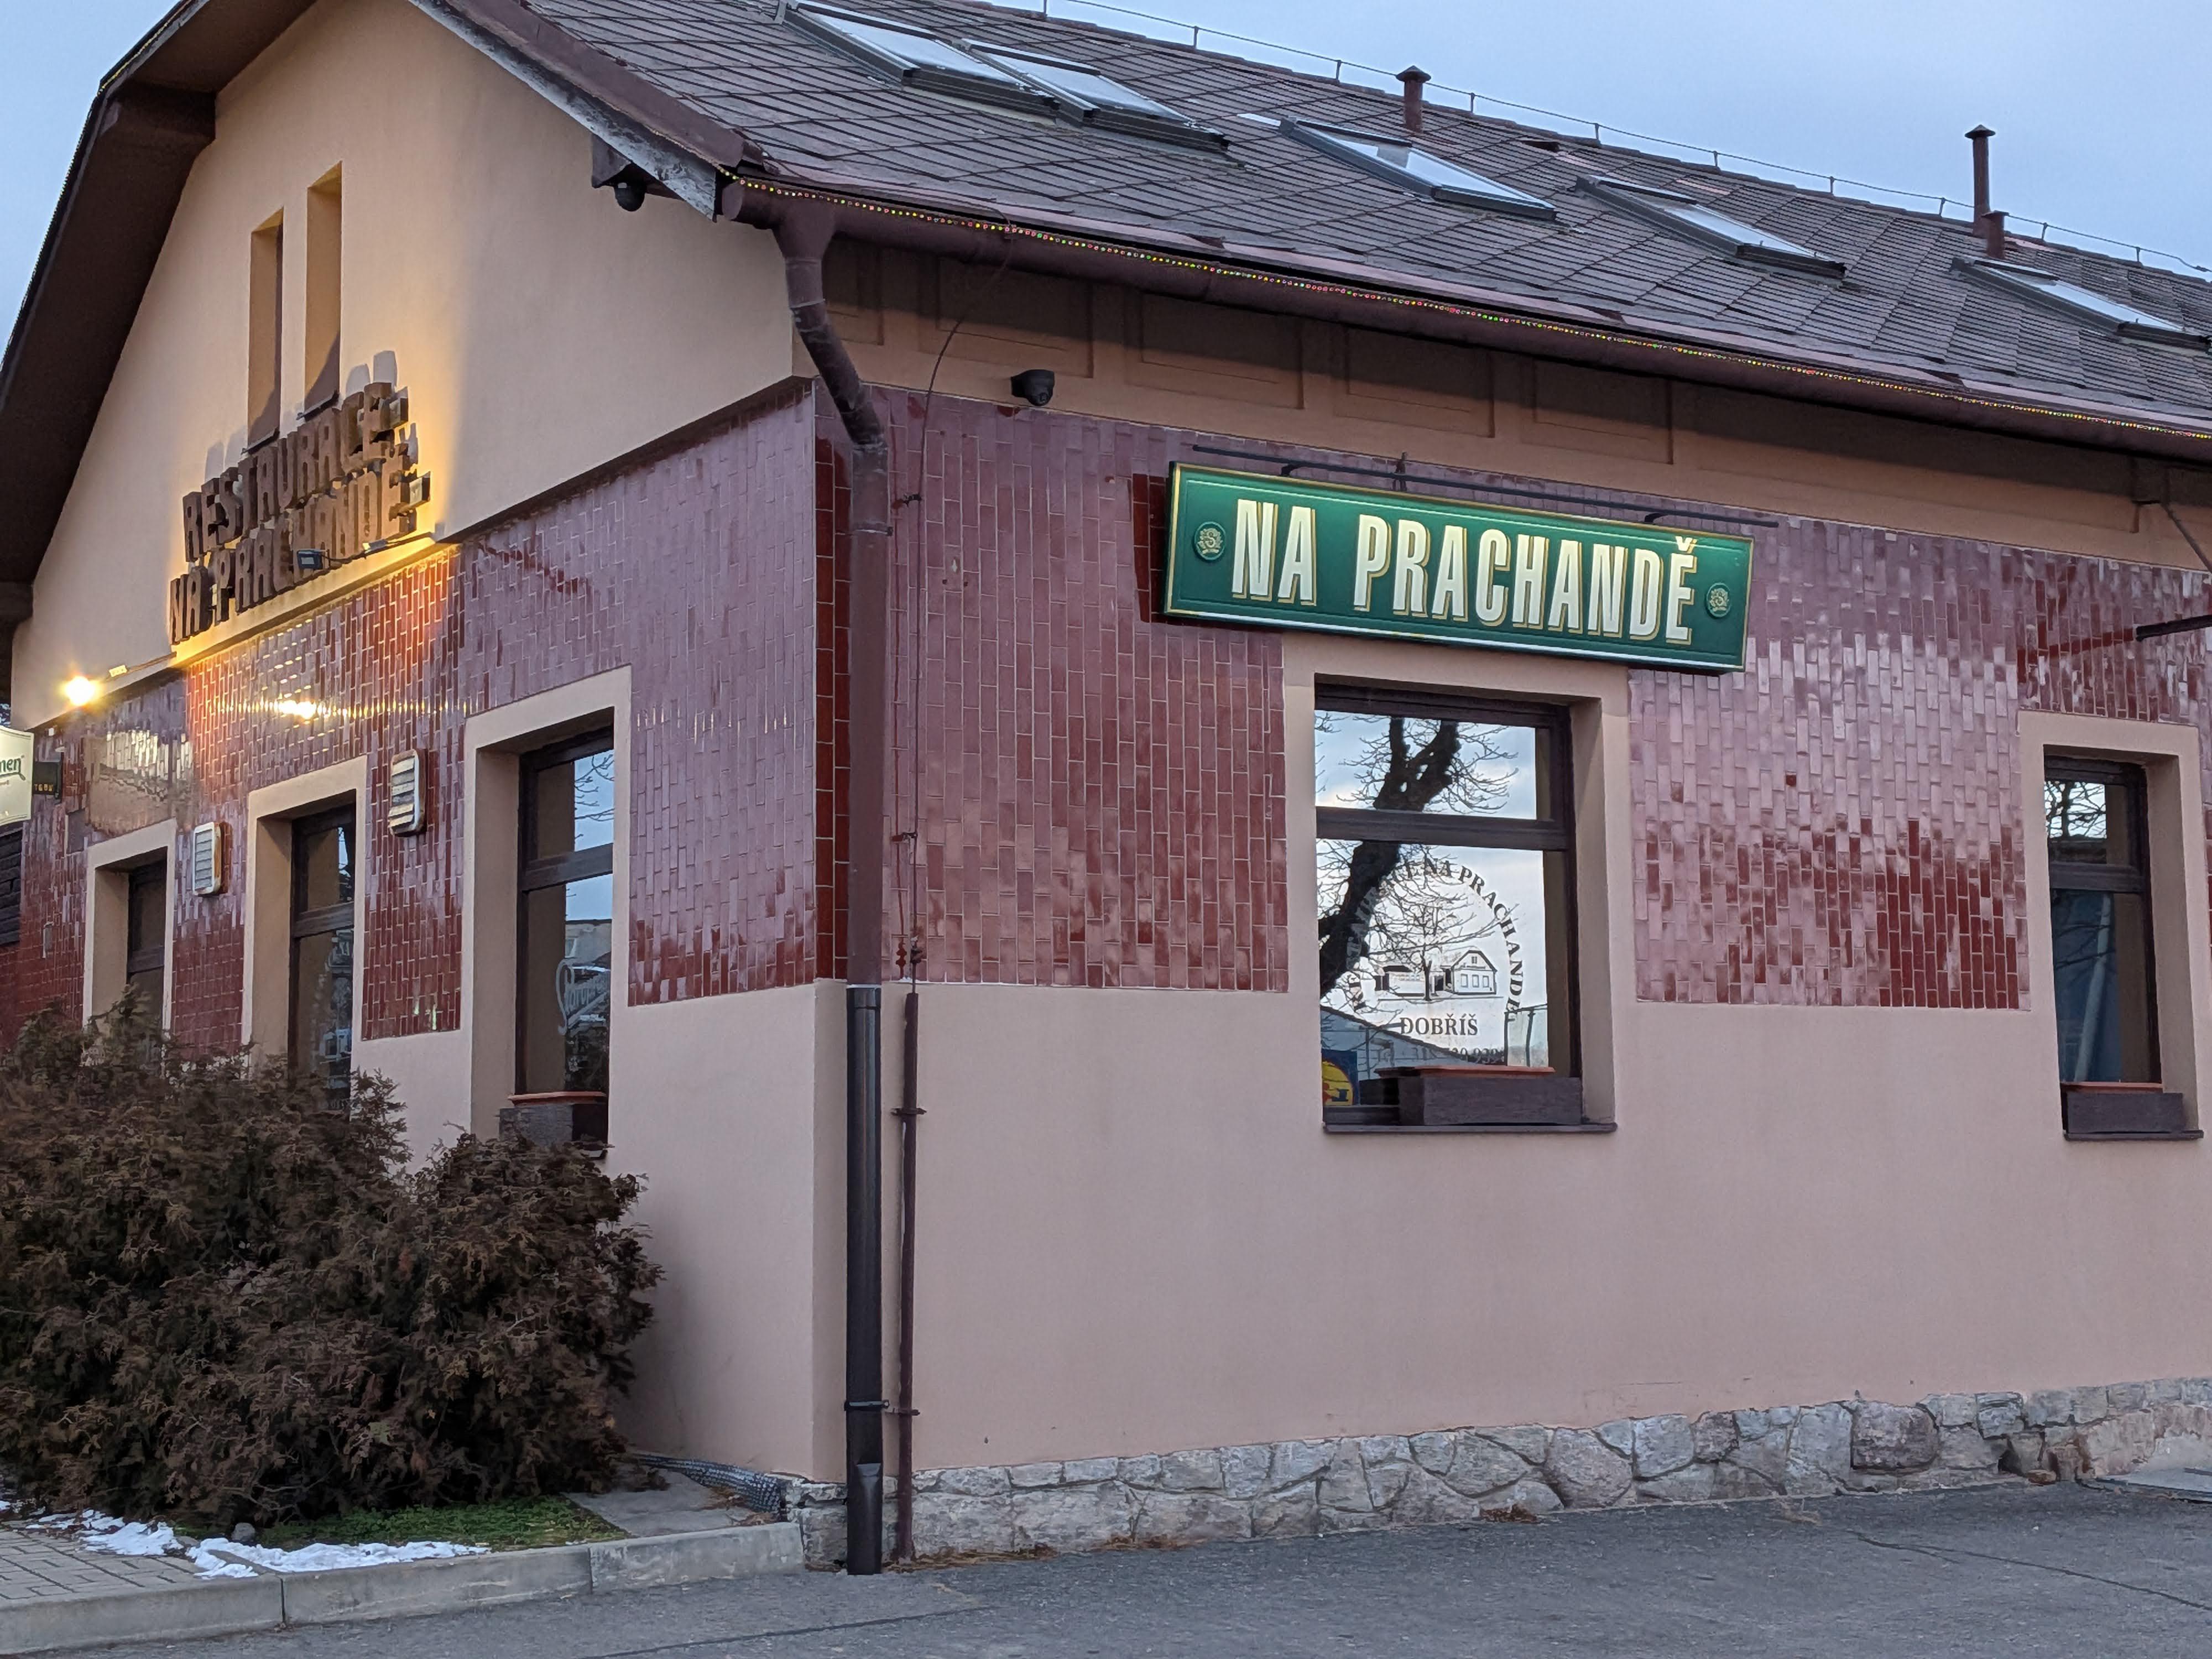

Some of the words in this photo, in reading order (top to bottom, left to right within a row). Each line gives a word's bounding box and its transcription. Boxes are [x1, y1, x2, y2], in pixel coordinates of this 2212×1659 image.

[183, 382, 393, 562] RESTAURACE
[170, 566, 213, 646] NA
[1232, 499, 1316, 606] NA
[1354, 514, 1697, 645] PRACHANDĚ
[1400, 1013, 1478, 1036] DOBŘÍŠ
